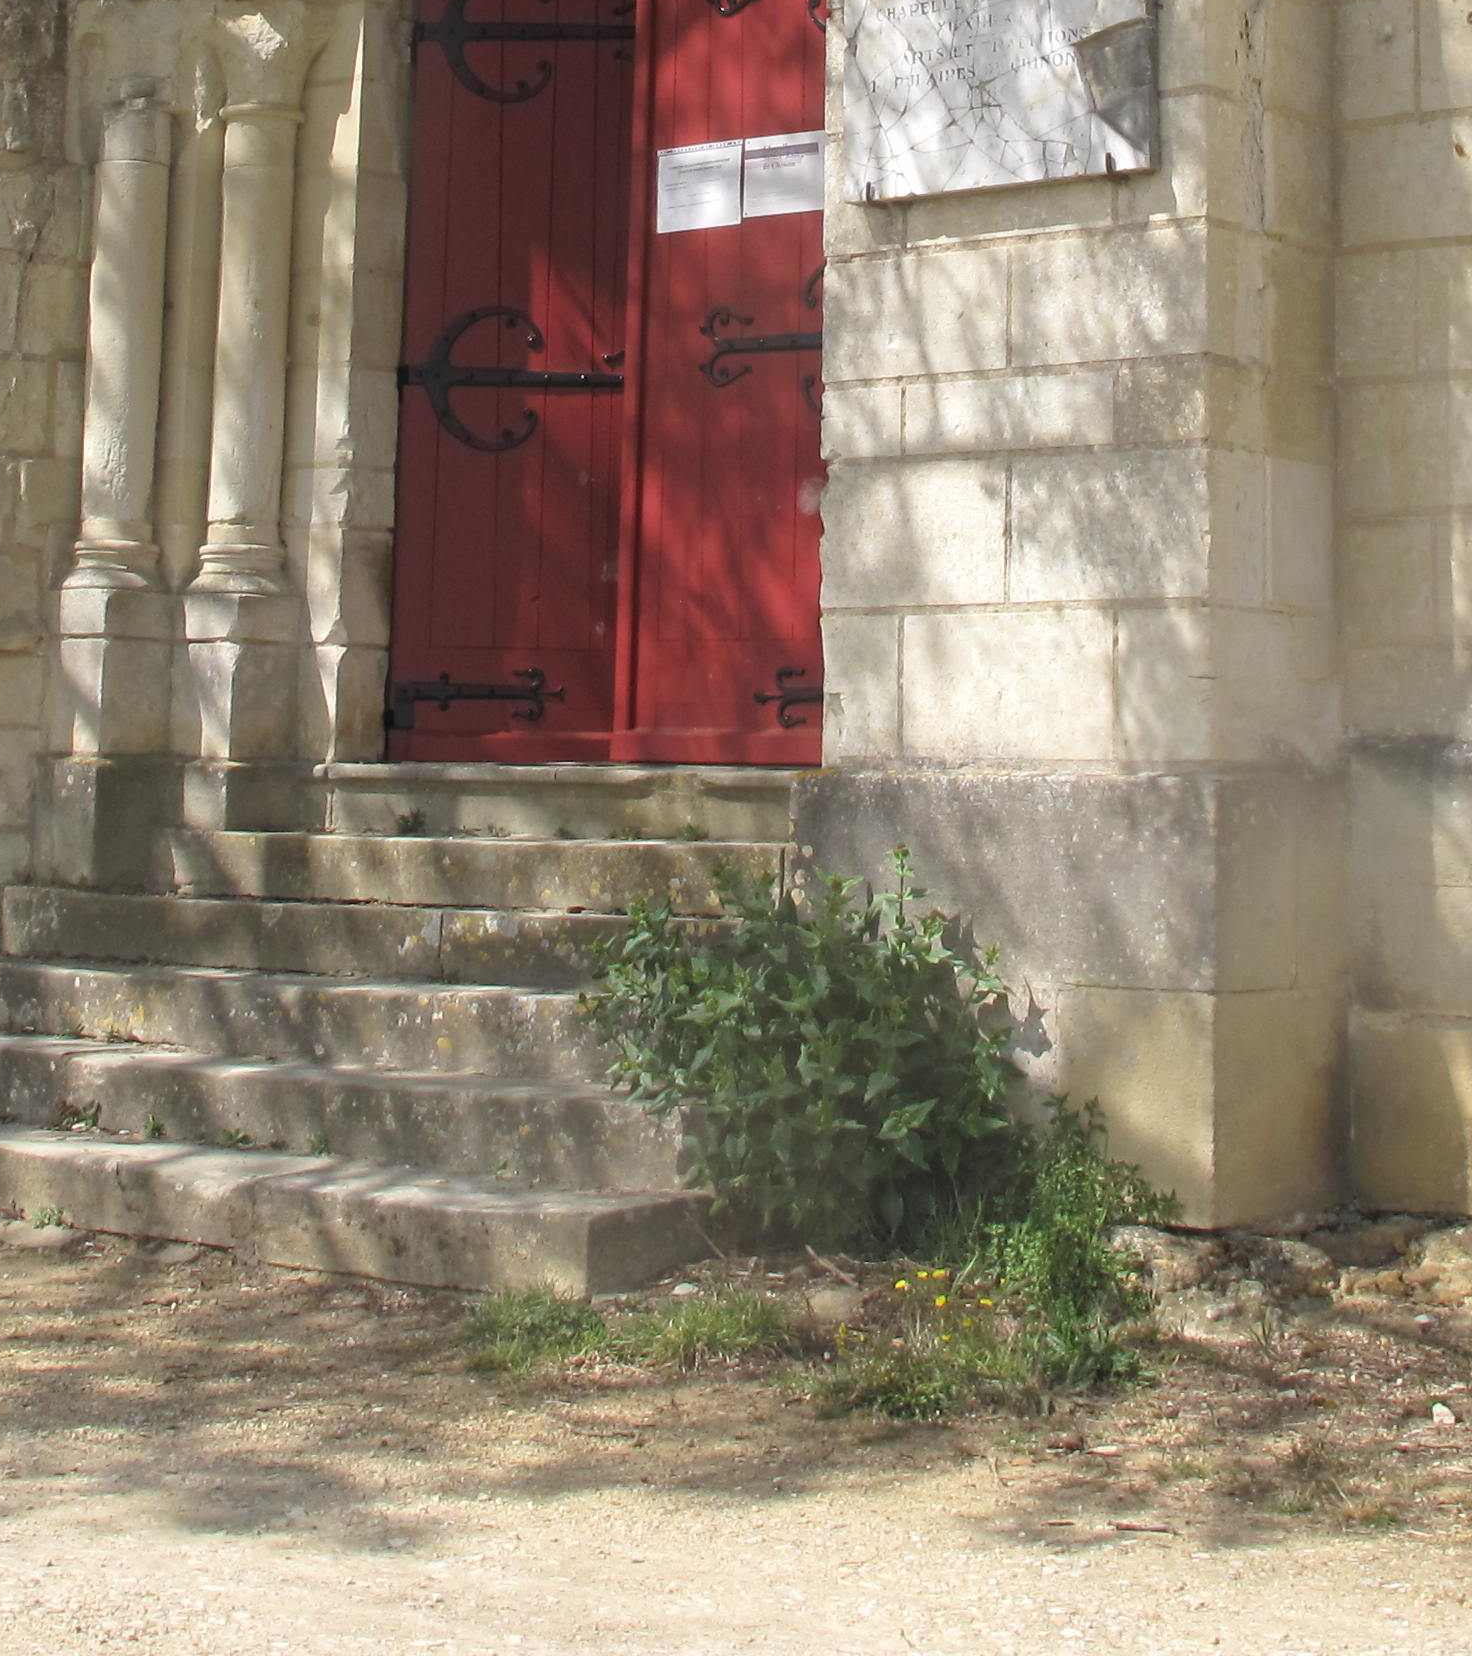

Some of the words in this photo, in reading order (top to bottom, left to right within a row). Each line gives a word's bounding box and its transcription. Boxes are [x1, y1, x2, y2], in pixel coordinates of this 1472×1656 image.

[902, 48, 944, 65] ARTS
[980, 26, 1090, 53] TRAITIONS
[870, 66, 976, 93] PPUAIRES
[1010, 51, 1077, 73] CHINON
